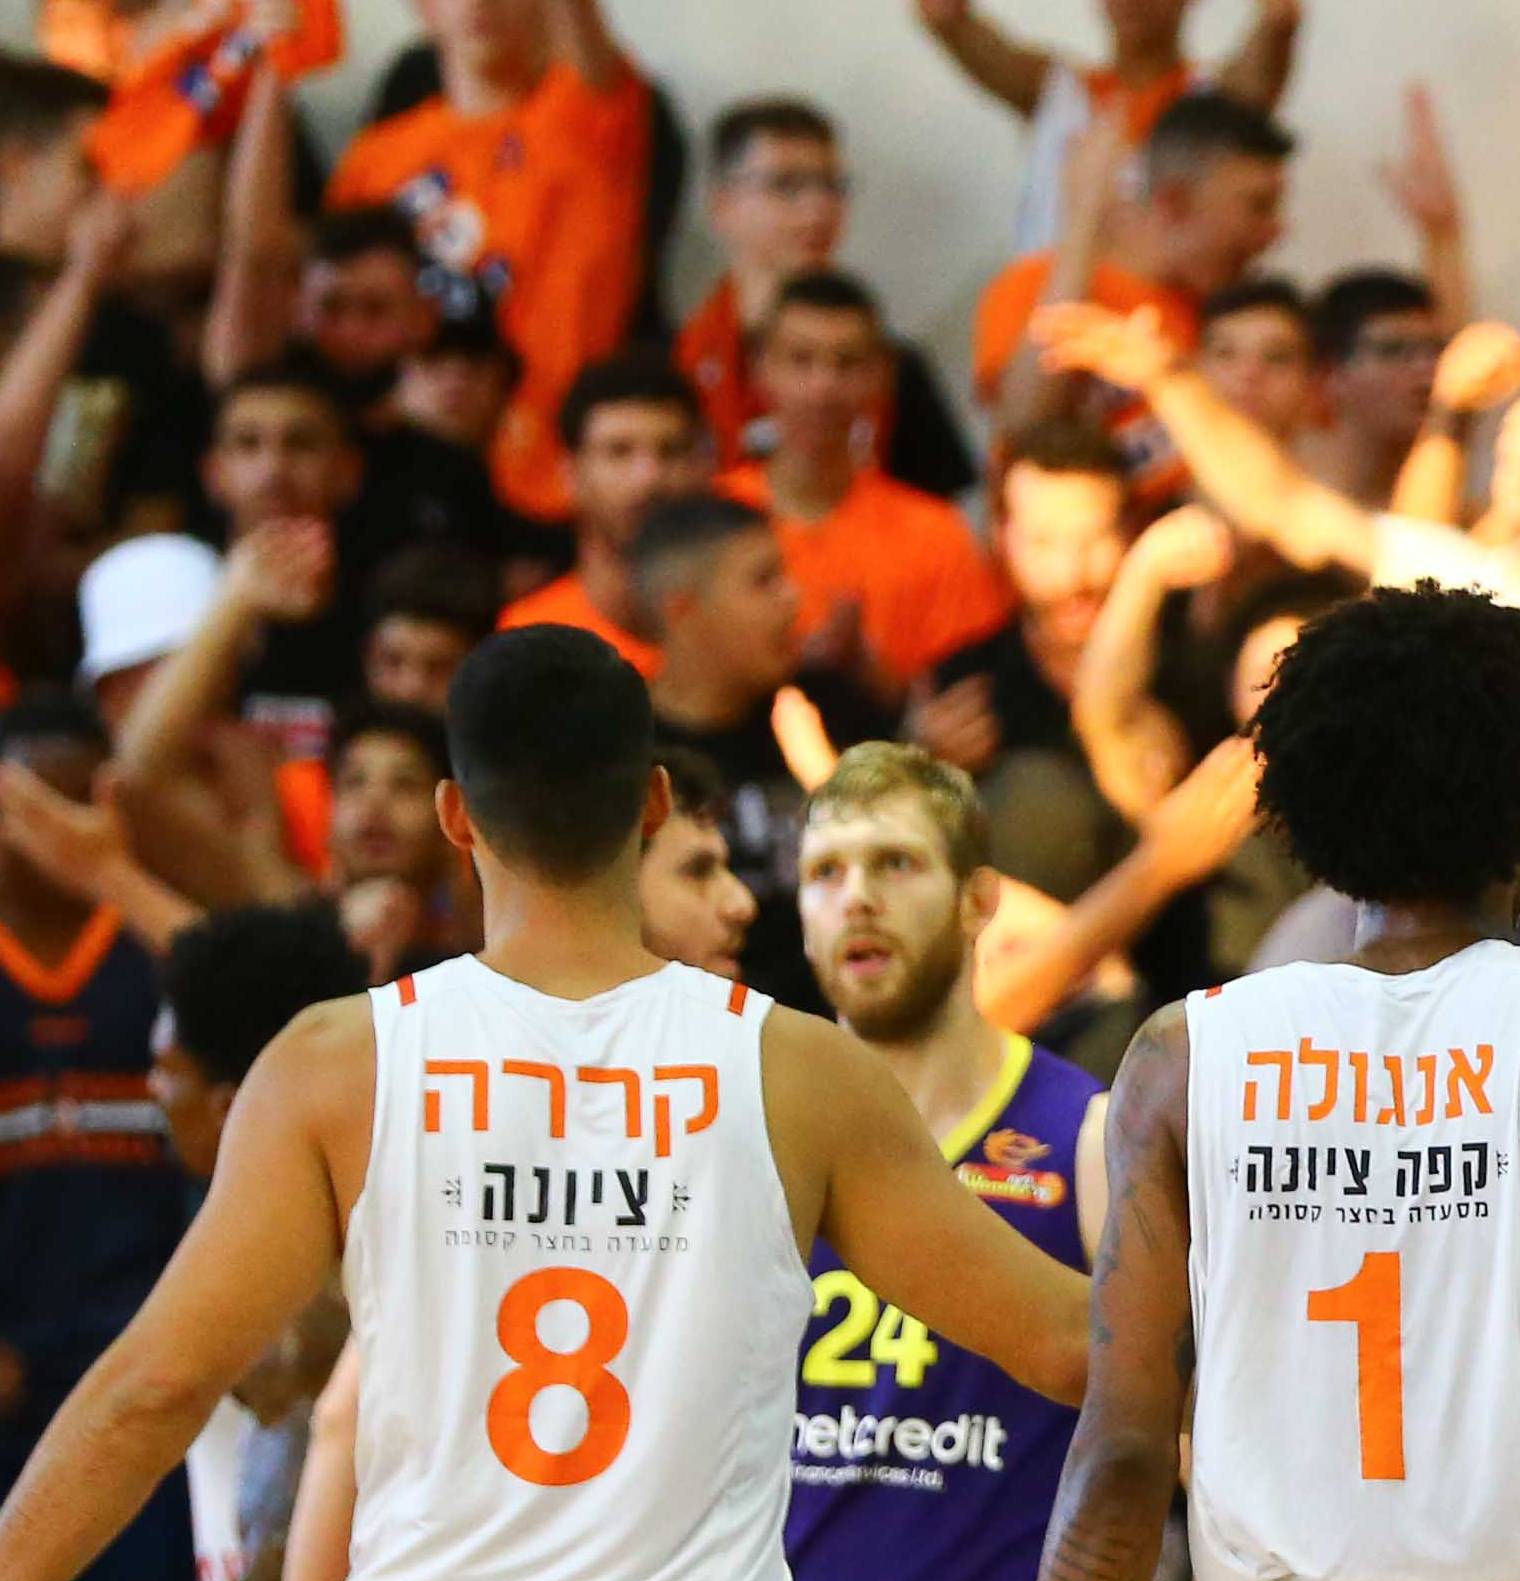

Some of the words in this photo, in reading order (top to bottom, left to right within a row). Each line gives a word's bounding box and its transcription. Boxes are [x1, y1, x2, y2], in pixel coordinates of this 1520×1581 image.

[423, 1057, 720, 1158] קררה
[1242, 1036, 1495, 1127] אנגולה
[482, 1162, 649, 1226] ציונה
[1246, 1145, 1371, 1196] ציונה
[1395, 1141, 1489, 1198] קפה
[443, 1227, 518, 1251] קסומה
[529, 1233, 593, 1252] בחצר
[605, 1234, 690, 1252] מסעדה
[1408, 1201, 1489, 1225] מסעדה
[802, 1269, 939, 1389] 24
[486, 1266, 632, 1486] 8
[1306, 1250, 1406, 1480] 1
[791, 1403, 1009, 1473] netcredit
